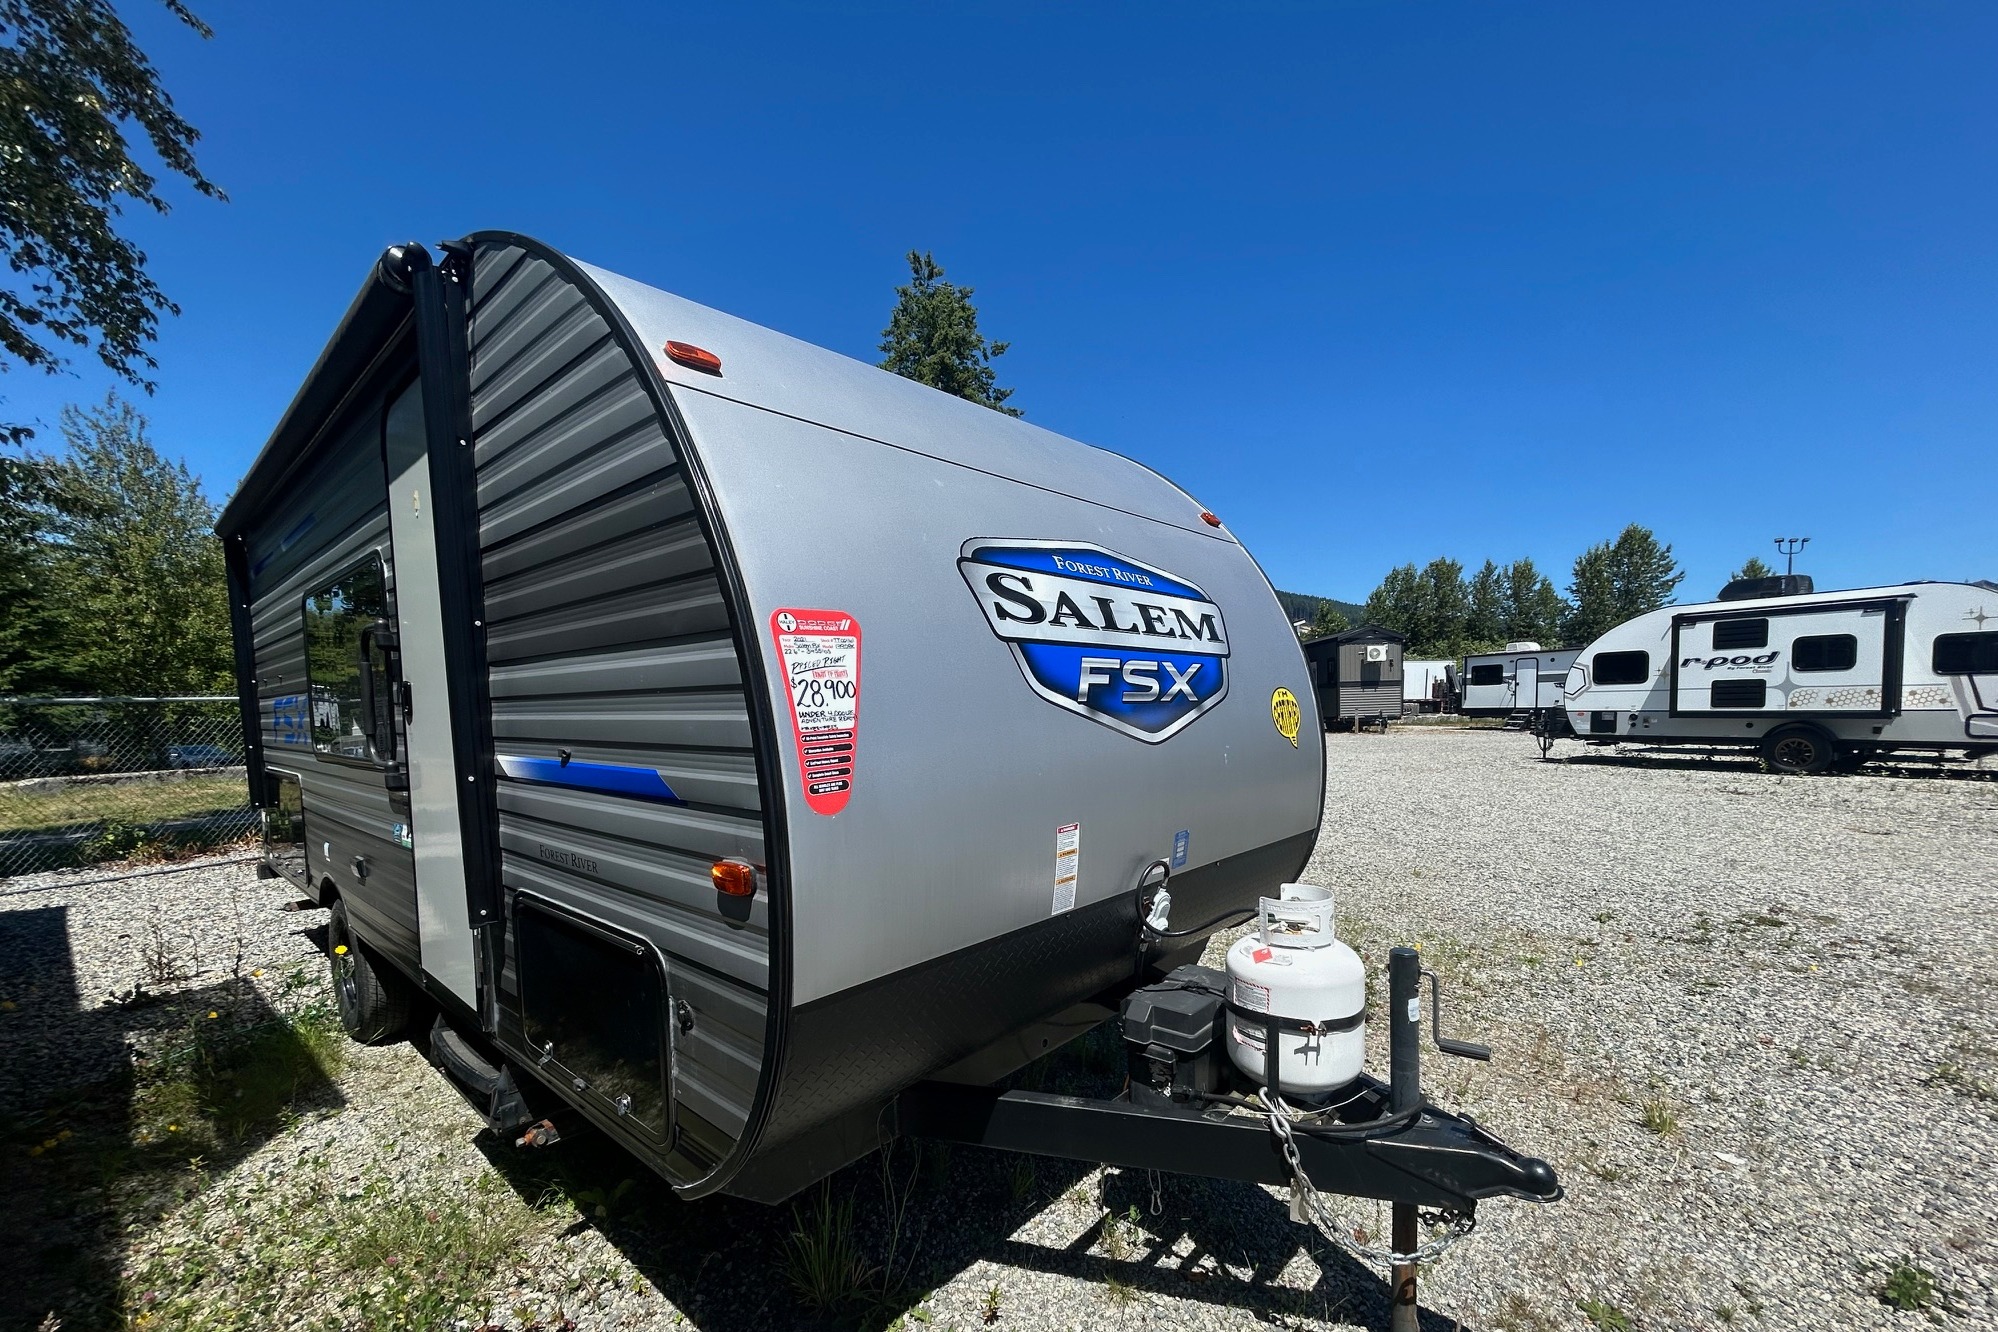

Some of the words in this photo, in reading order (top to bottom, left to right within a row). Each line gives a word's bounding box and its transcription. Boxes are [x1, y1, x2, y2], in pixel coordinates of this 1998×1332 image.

[1052, 555, 1111, 579] FOREST
[1113, 567, 1154, 586] RIVER
[986, 572, 1225, 644] SALEM
[1077, 656, 1202, 704] FSX
[798, 709, 826, 718] UNDER
[801, 716, 837, 724] ADVENTURE
[539, 843, 570, 865] FOREST
[571, 853, 599, 874] RIVER
